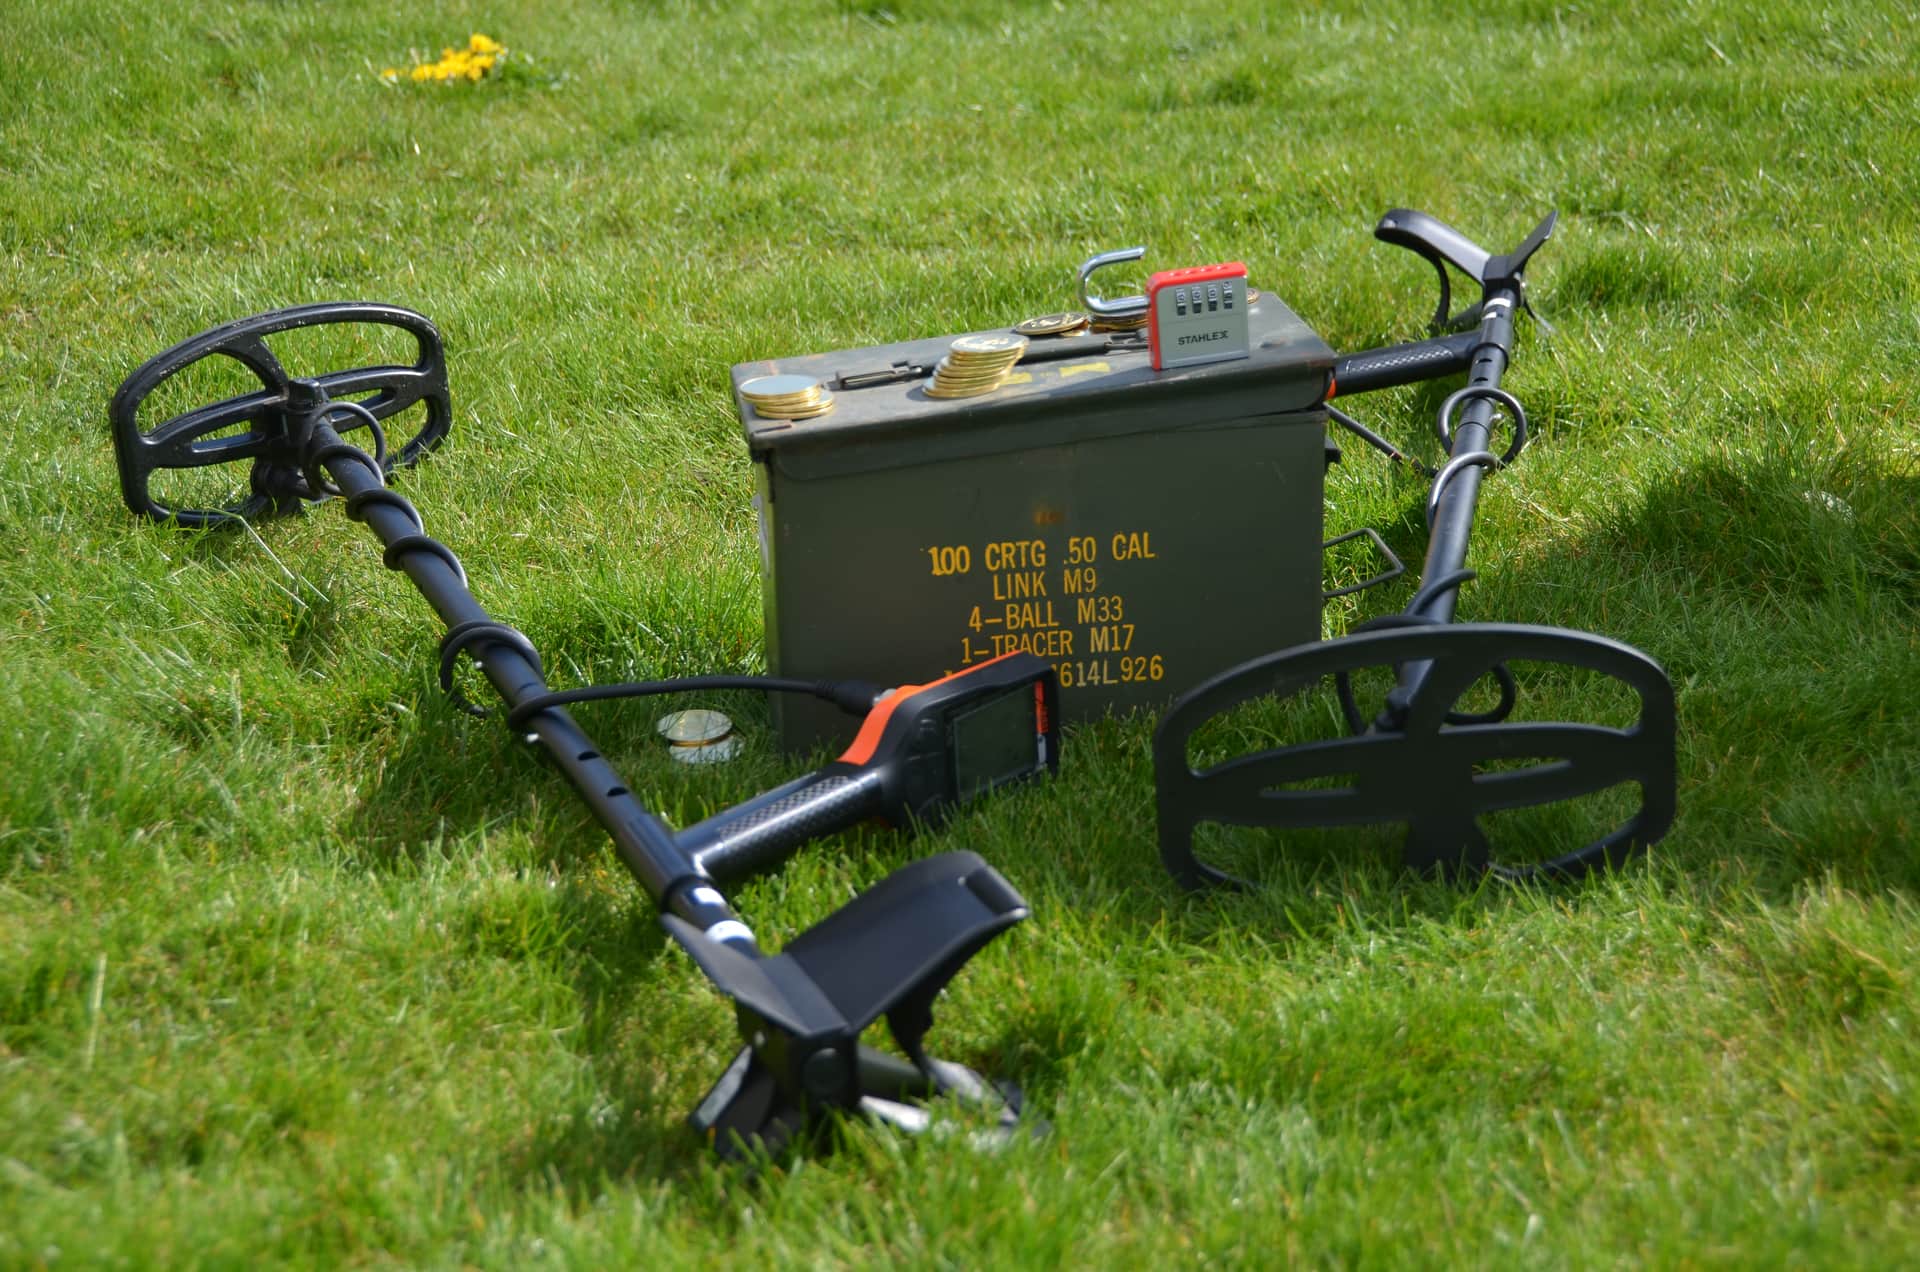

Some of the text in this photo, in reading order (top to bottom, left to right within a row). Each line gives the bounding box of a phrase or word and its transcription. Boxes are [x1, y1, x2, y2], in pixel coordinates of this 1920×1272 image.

[1177, 330, 1229, 346] STAHLEX
[928, 532, 1155, 576] 100 CRTG .50 CAL
[993, 567, 1097, 600] LINK M9
[1077, 596, 1123, 624] M33
[1090, 624, 1135, 653] M17
[1051, 654, 1164, 687] 614L926
